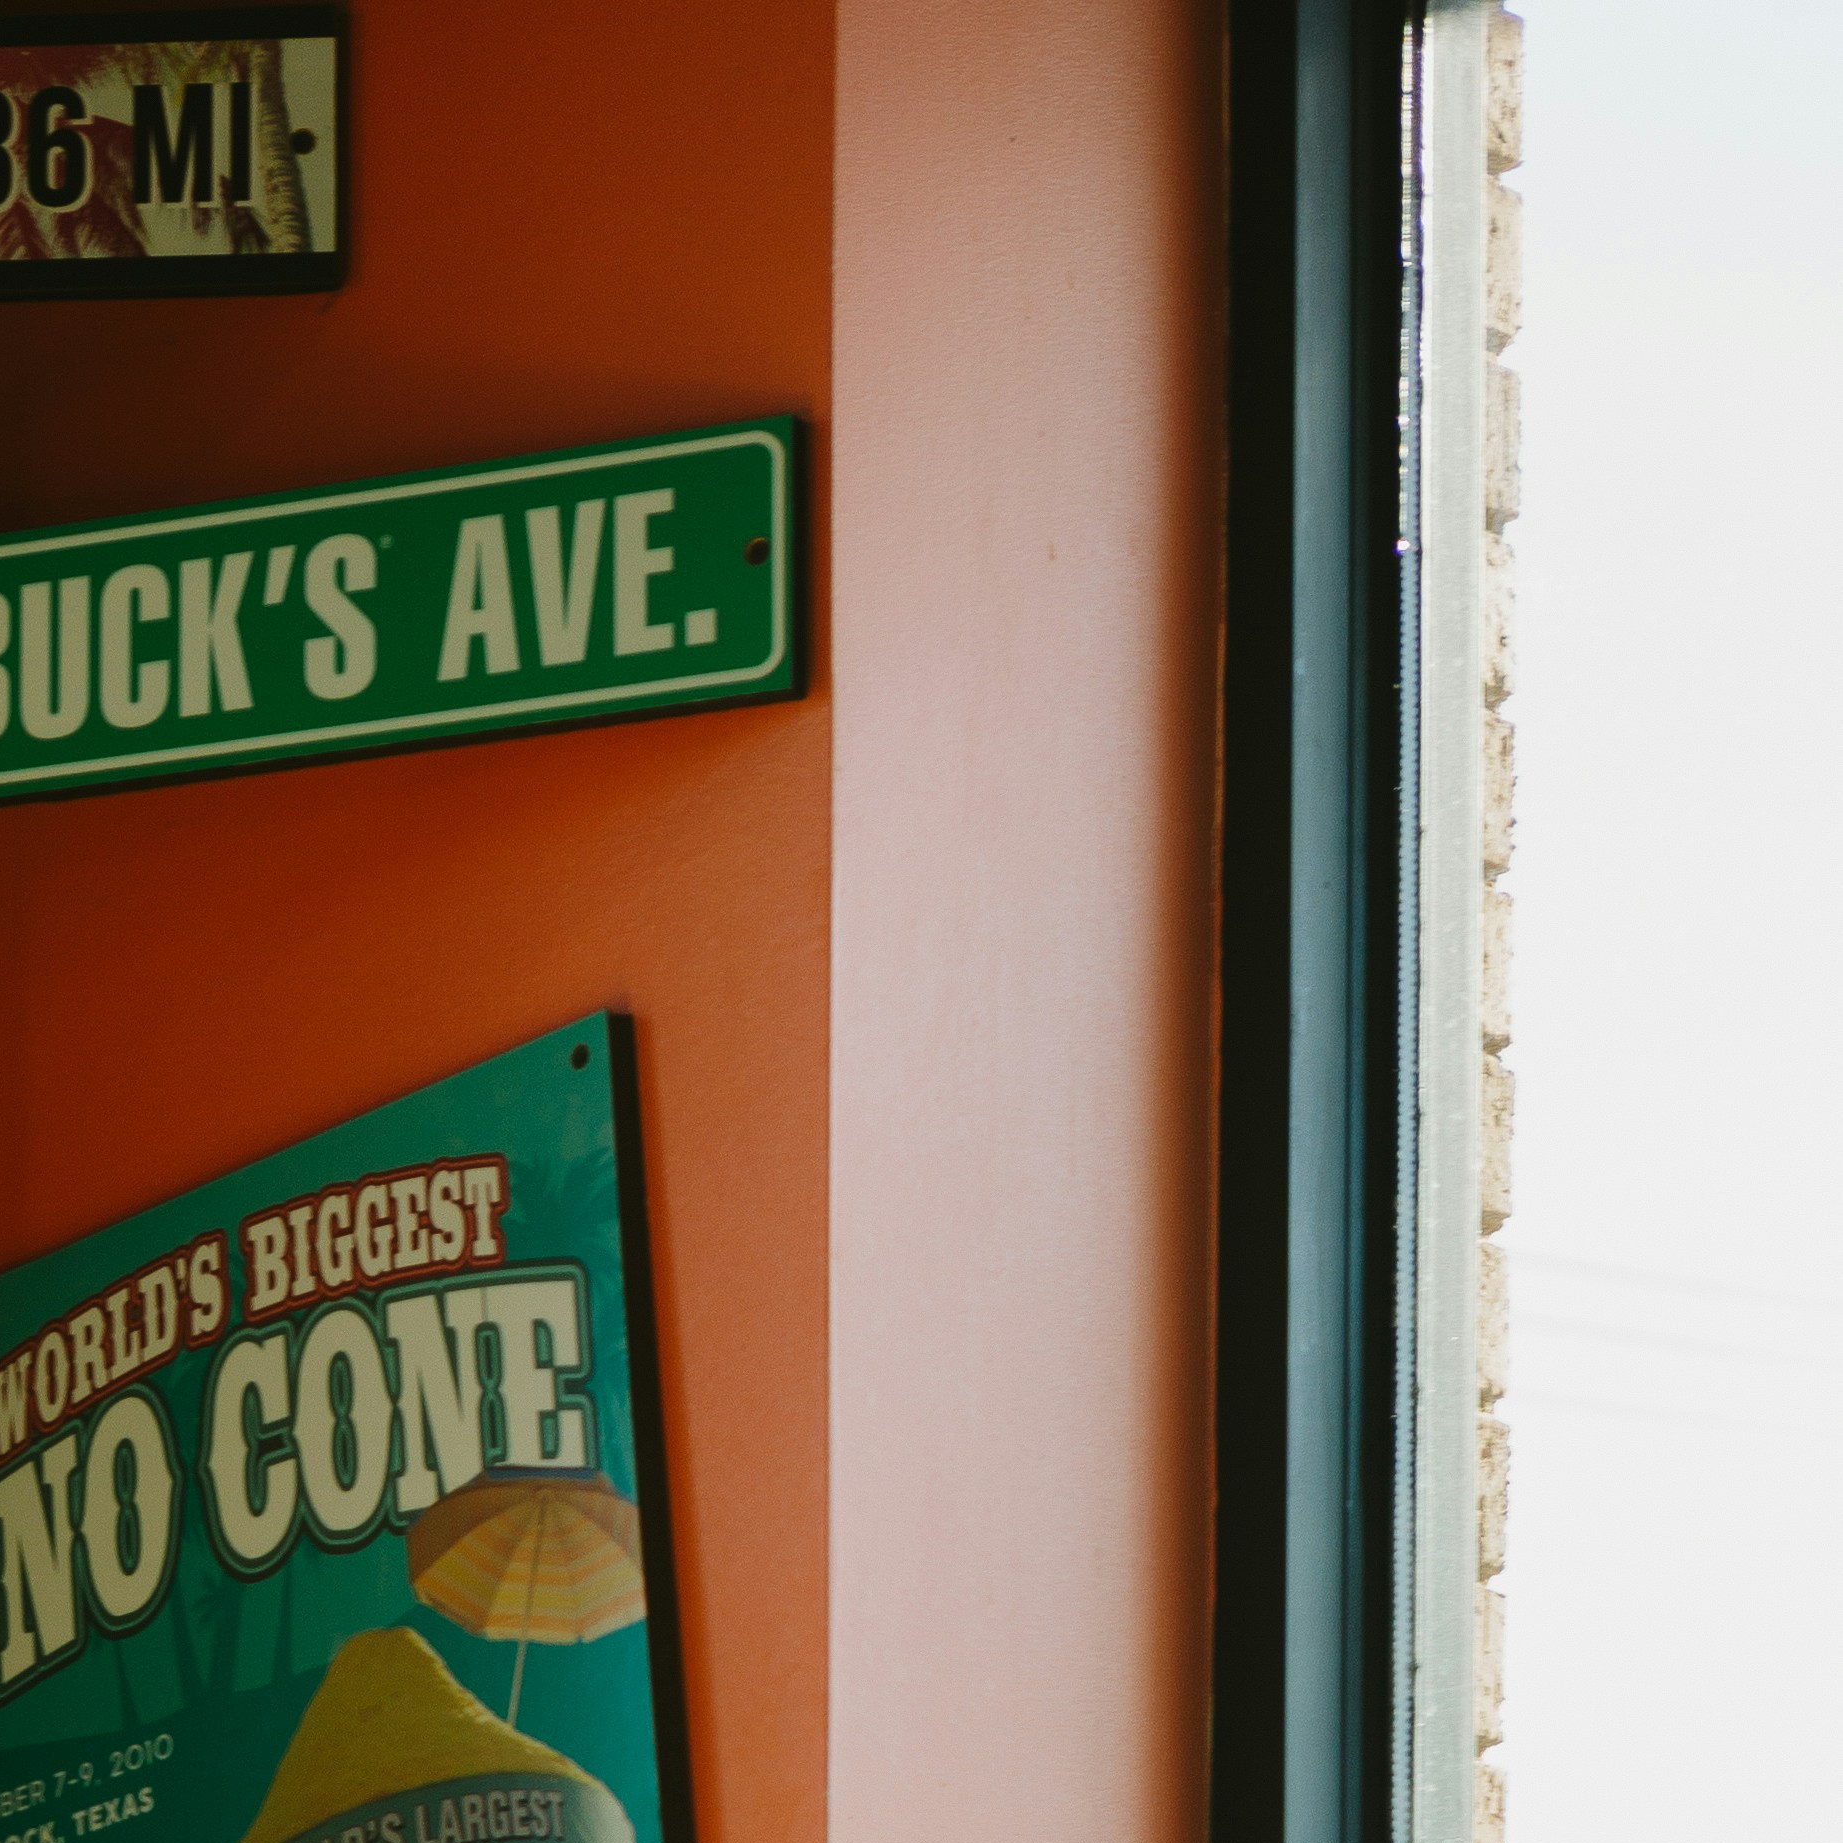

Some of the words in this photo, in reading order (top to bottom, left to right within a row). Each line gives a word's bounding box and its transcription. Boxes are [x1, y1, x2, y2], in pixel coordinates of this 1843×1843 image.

[131, 81, 252, 207] MI
[435, 486, 720, 684] AVE.
[243, 1162, 506, 1316] BIGGEST
[205, 1277, 589, 1562] CONE
[72, 1786, 155, 1836] TEXAS
[109, 1733, 174, 1779] 2010
